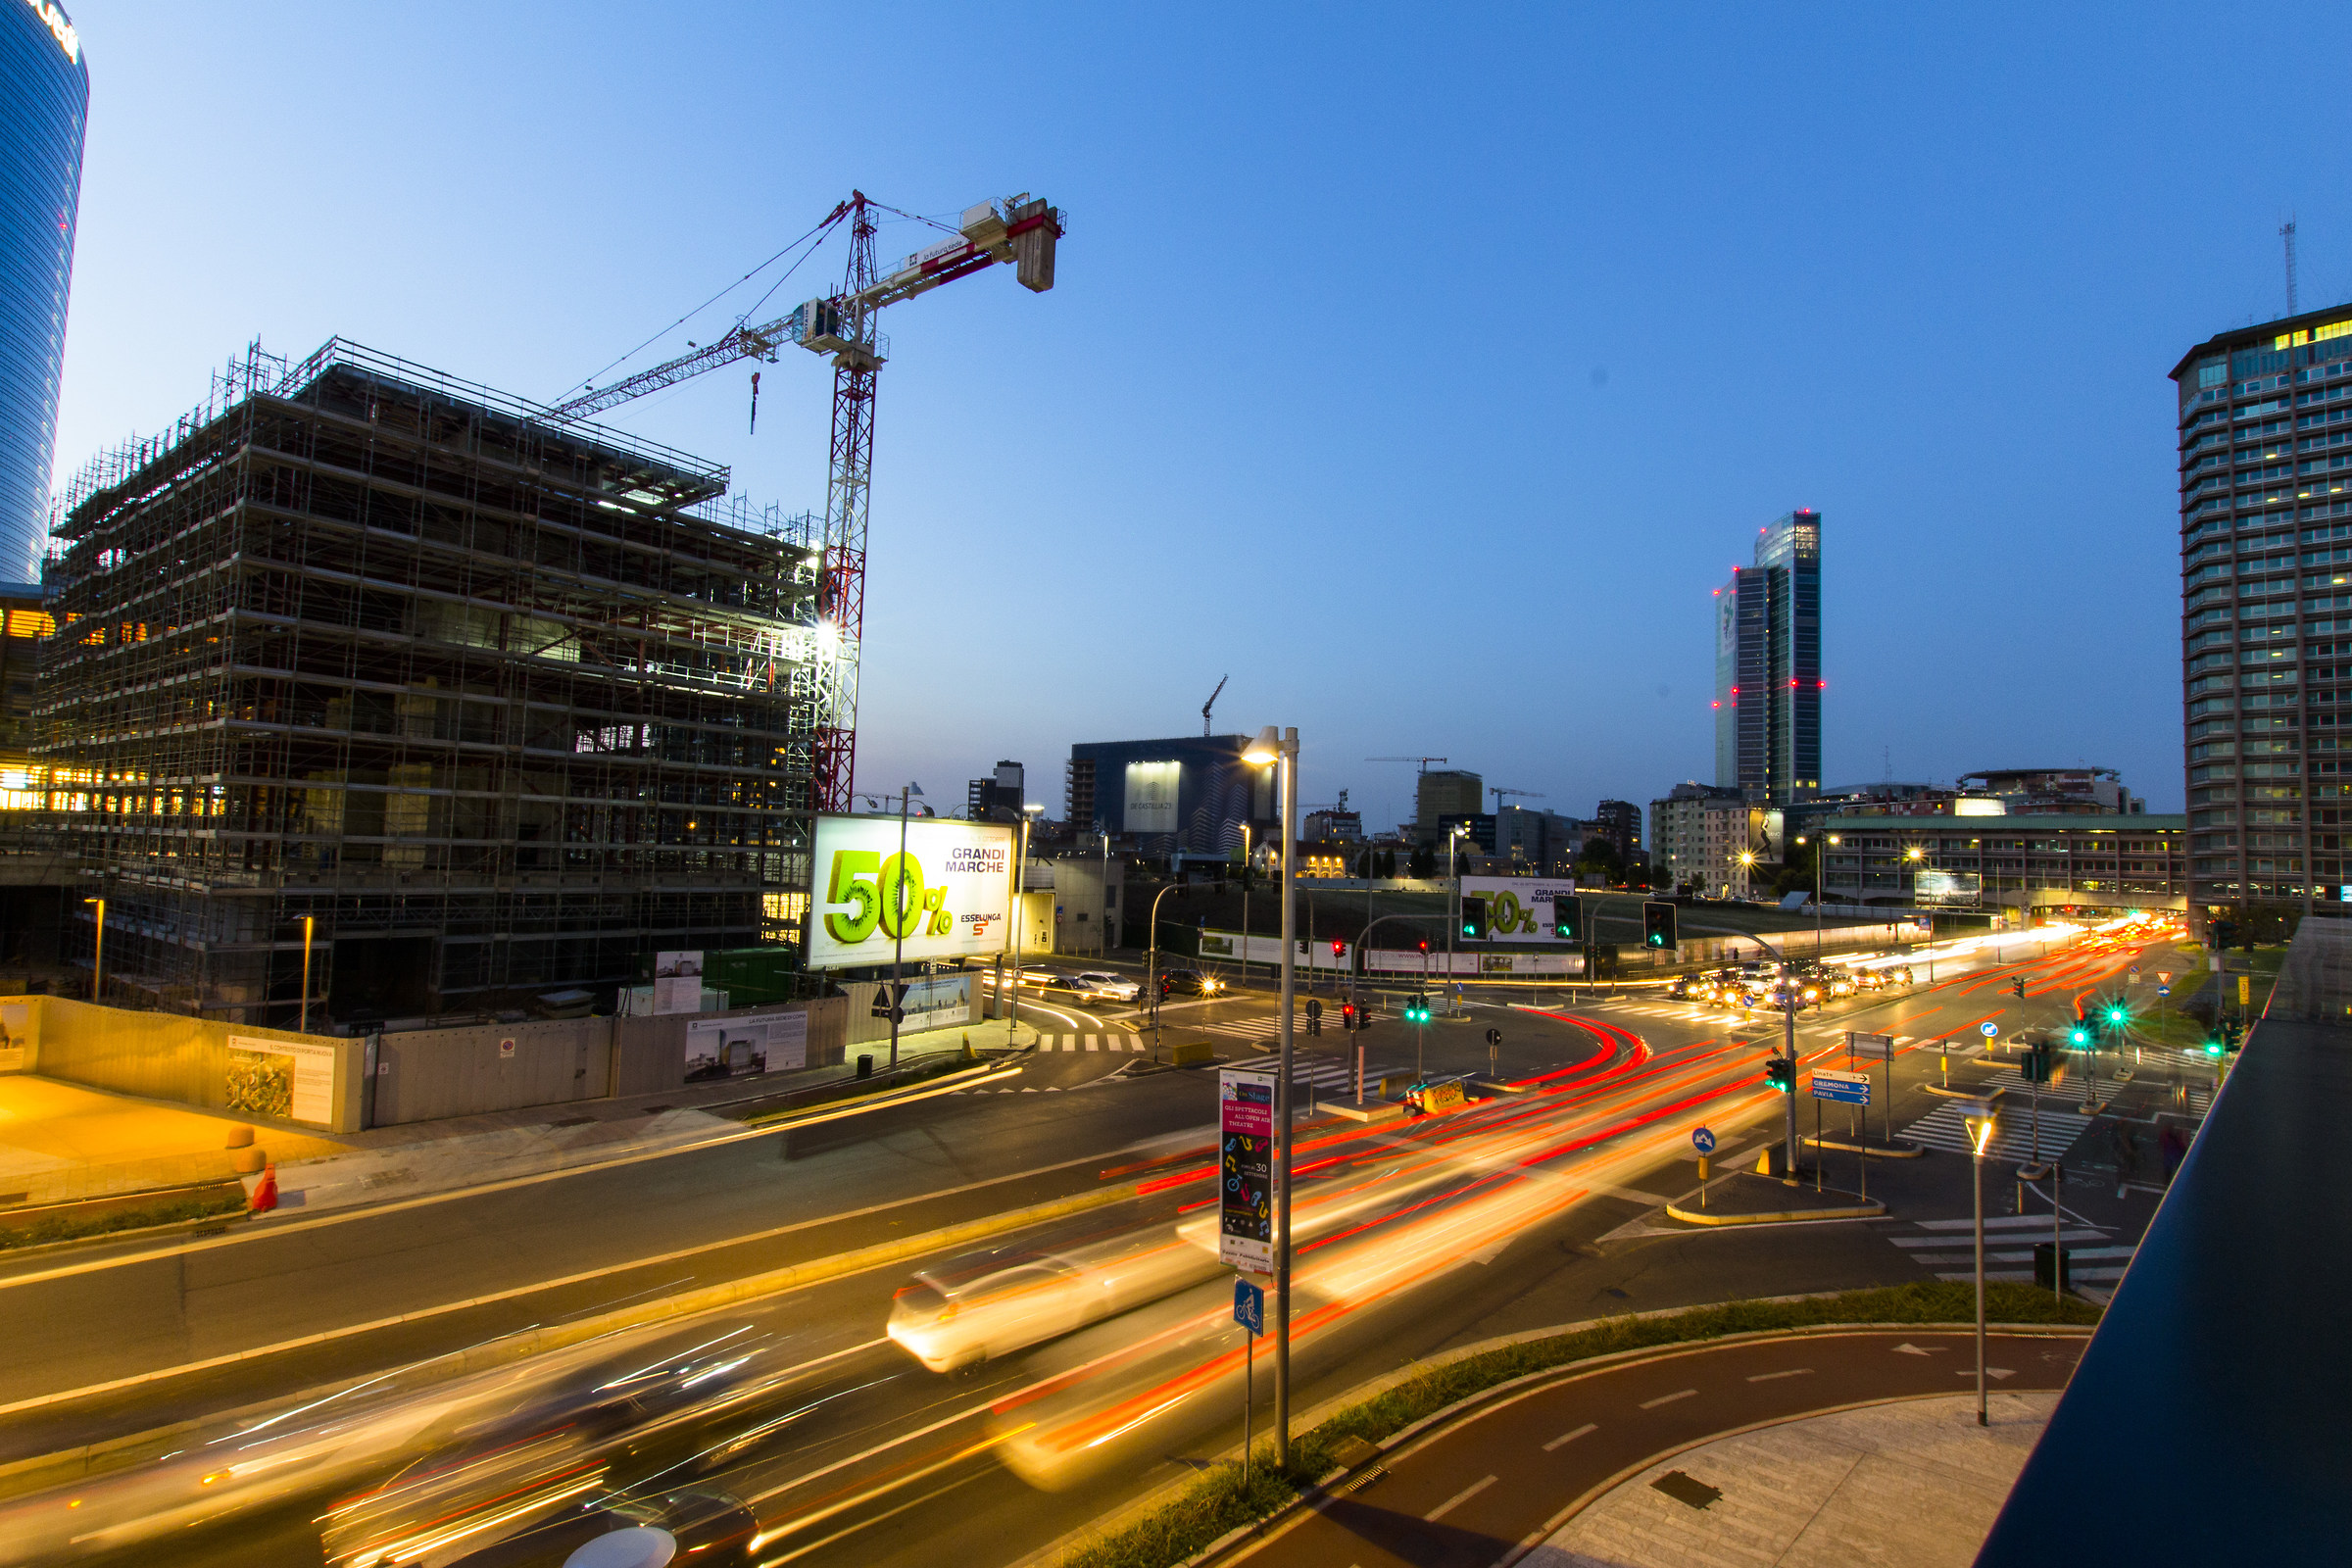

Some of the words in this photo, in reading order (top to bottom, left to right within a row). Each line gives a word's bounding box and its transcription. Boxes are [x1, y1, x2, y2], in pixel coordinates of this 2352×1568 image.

[953, 848, 1004, 860] GRANDI
[946, 860, 1004, 872] MARCHE
[824, 850, 953, 943] 50%
[961, 913, 1002, 922] ESSELUNGA
[1813, 1080, 1849, 1090] CREMONA
[1248, 1091, 1270, 1102] Stage
[1235, 1106, 1267, 1115] SPETTACOLI
[1229, 1120, 1253, 1129] THEATRE
[1255, 1162, 1267, 1172] 30
